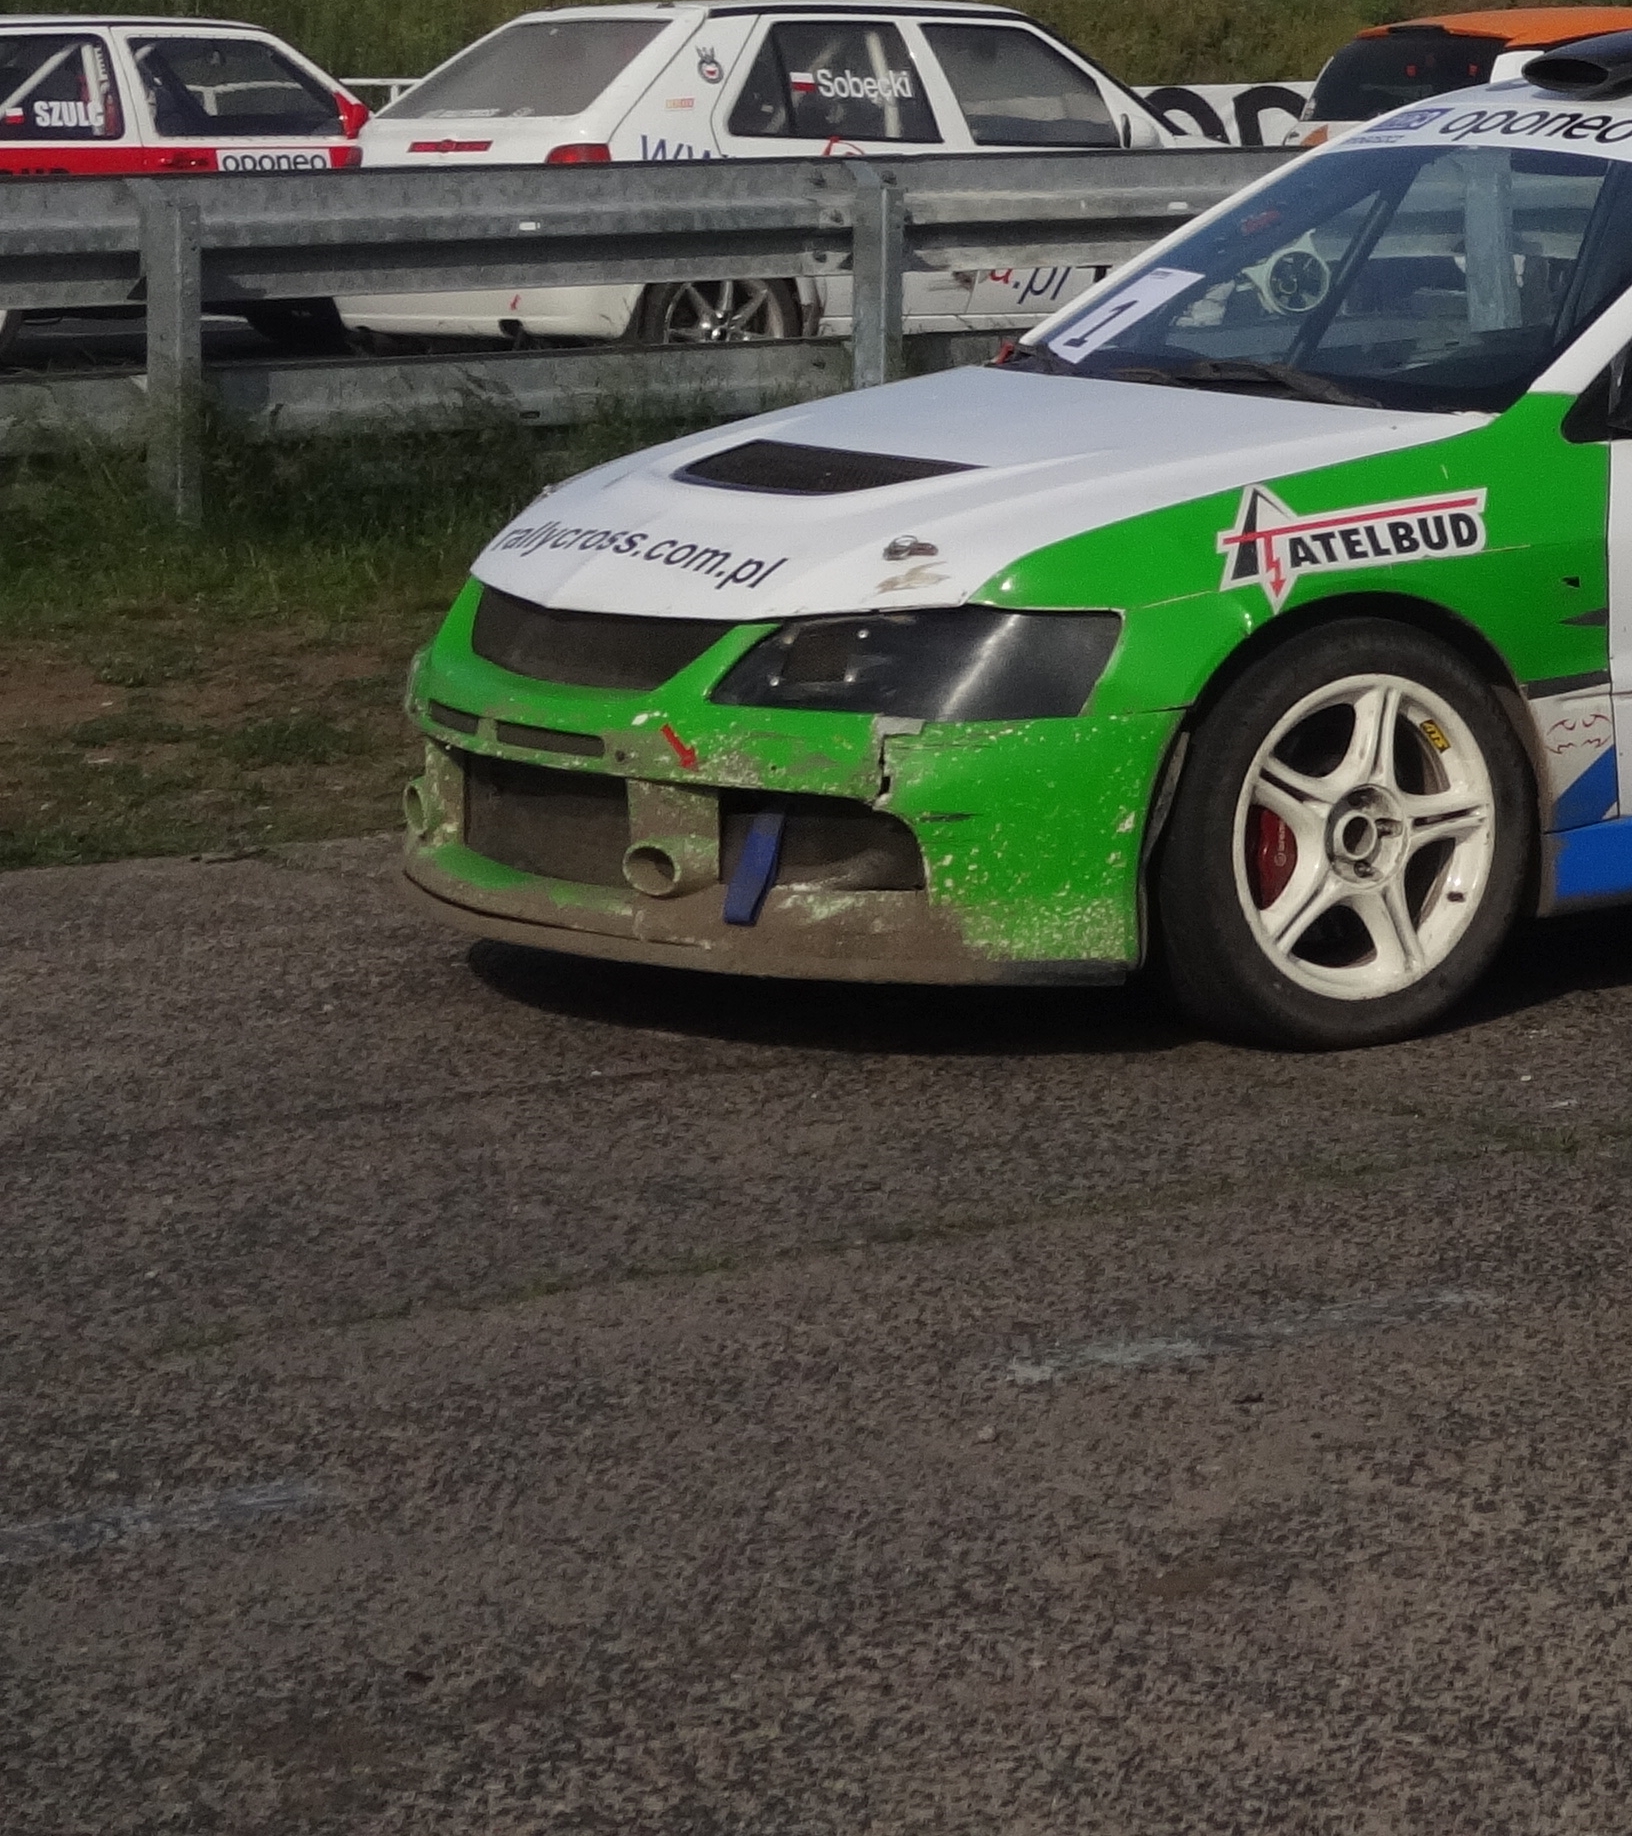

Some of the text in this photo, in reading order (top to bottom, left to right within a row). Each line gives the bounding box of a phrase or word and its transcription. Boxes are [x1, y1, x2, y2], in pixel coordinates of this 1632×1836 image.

[34, 100, 104, 127] SZULC
[1062, 299, 1140, 348] 1
[496, 521, 788, 590] rallycross.com.pl
[1289, 511, 1478, 569] ATELBUD
